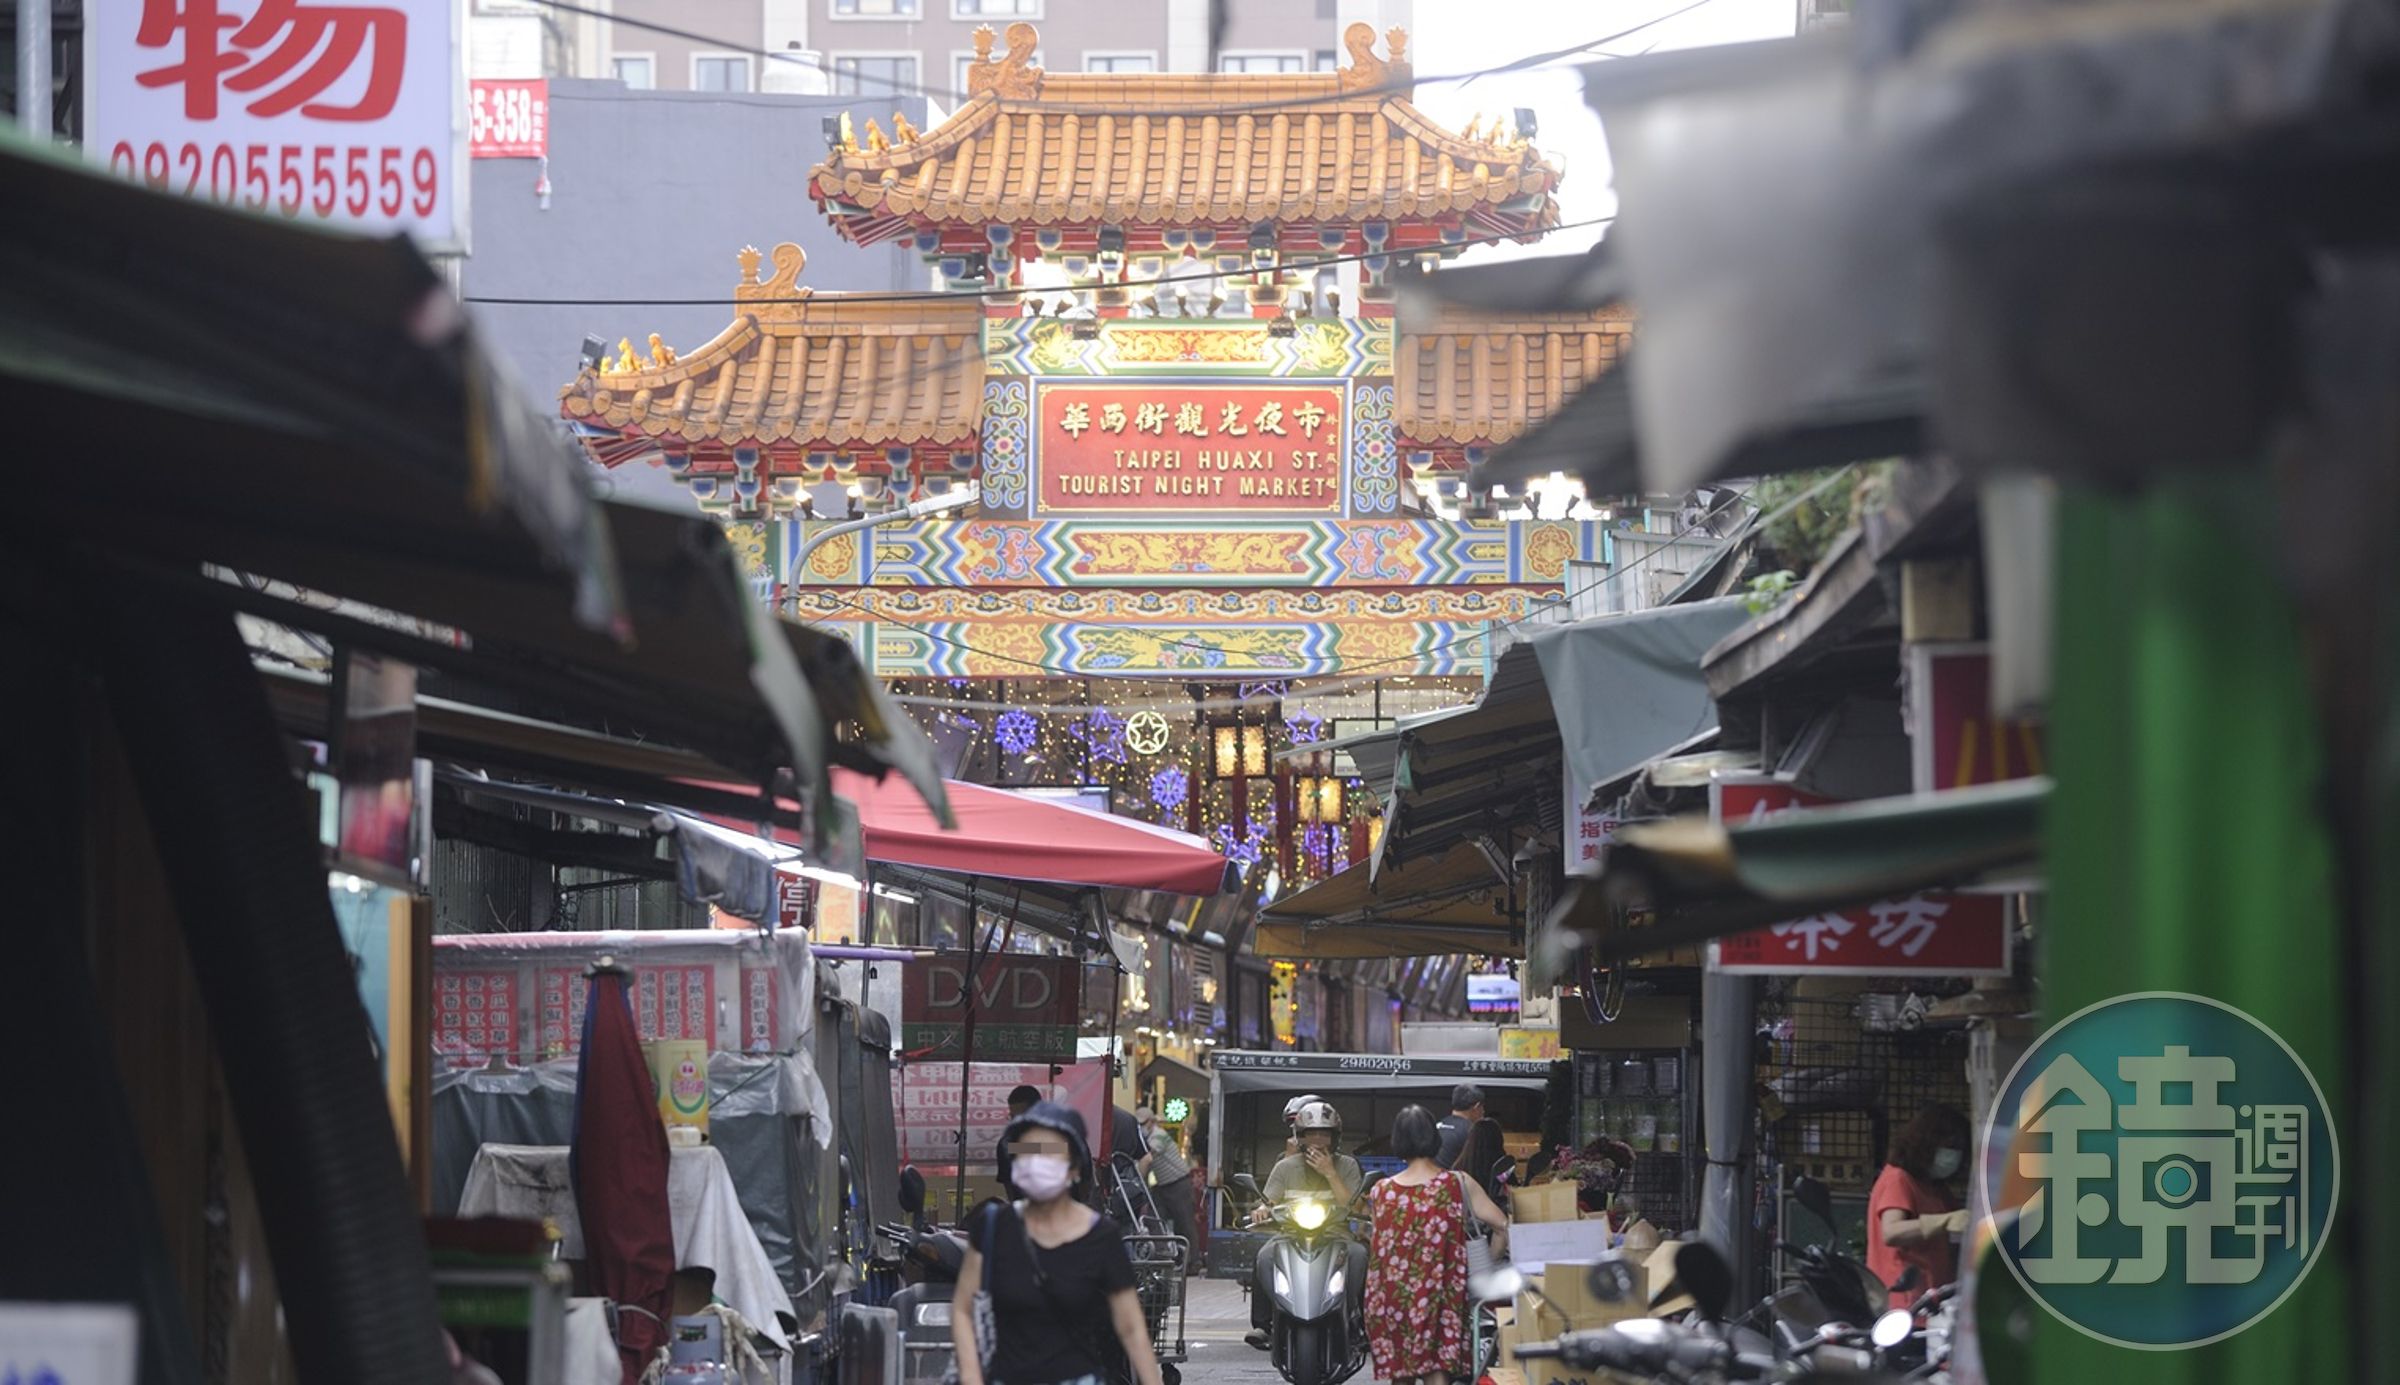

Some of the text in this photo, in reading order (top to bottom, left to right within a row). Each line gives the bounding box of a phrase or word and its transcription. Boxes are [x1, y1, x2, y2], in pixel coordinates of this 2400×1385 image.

[135, 0, 407, 122] 物
[469, 88, 531, 143] 5-358
[1059, 400, 1325, 439] 華西街觀光夜市
[1114, 449, 1323, 470] TAIPEI HUAXI ST.
[1059, 474, 1326, 497] TOURIST NIGHT MARKET
[928, 967, 1050, 1009] DVD
